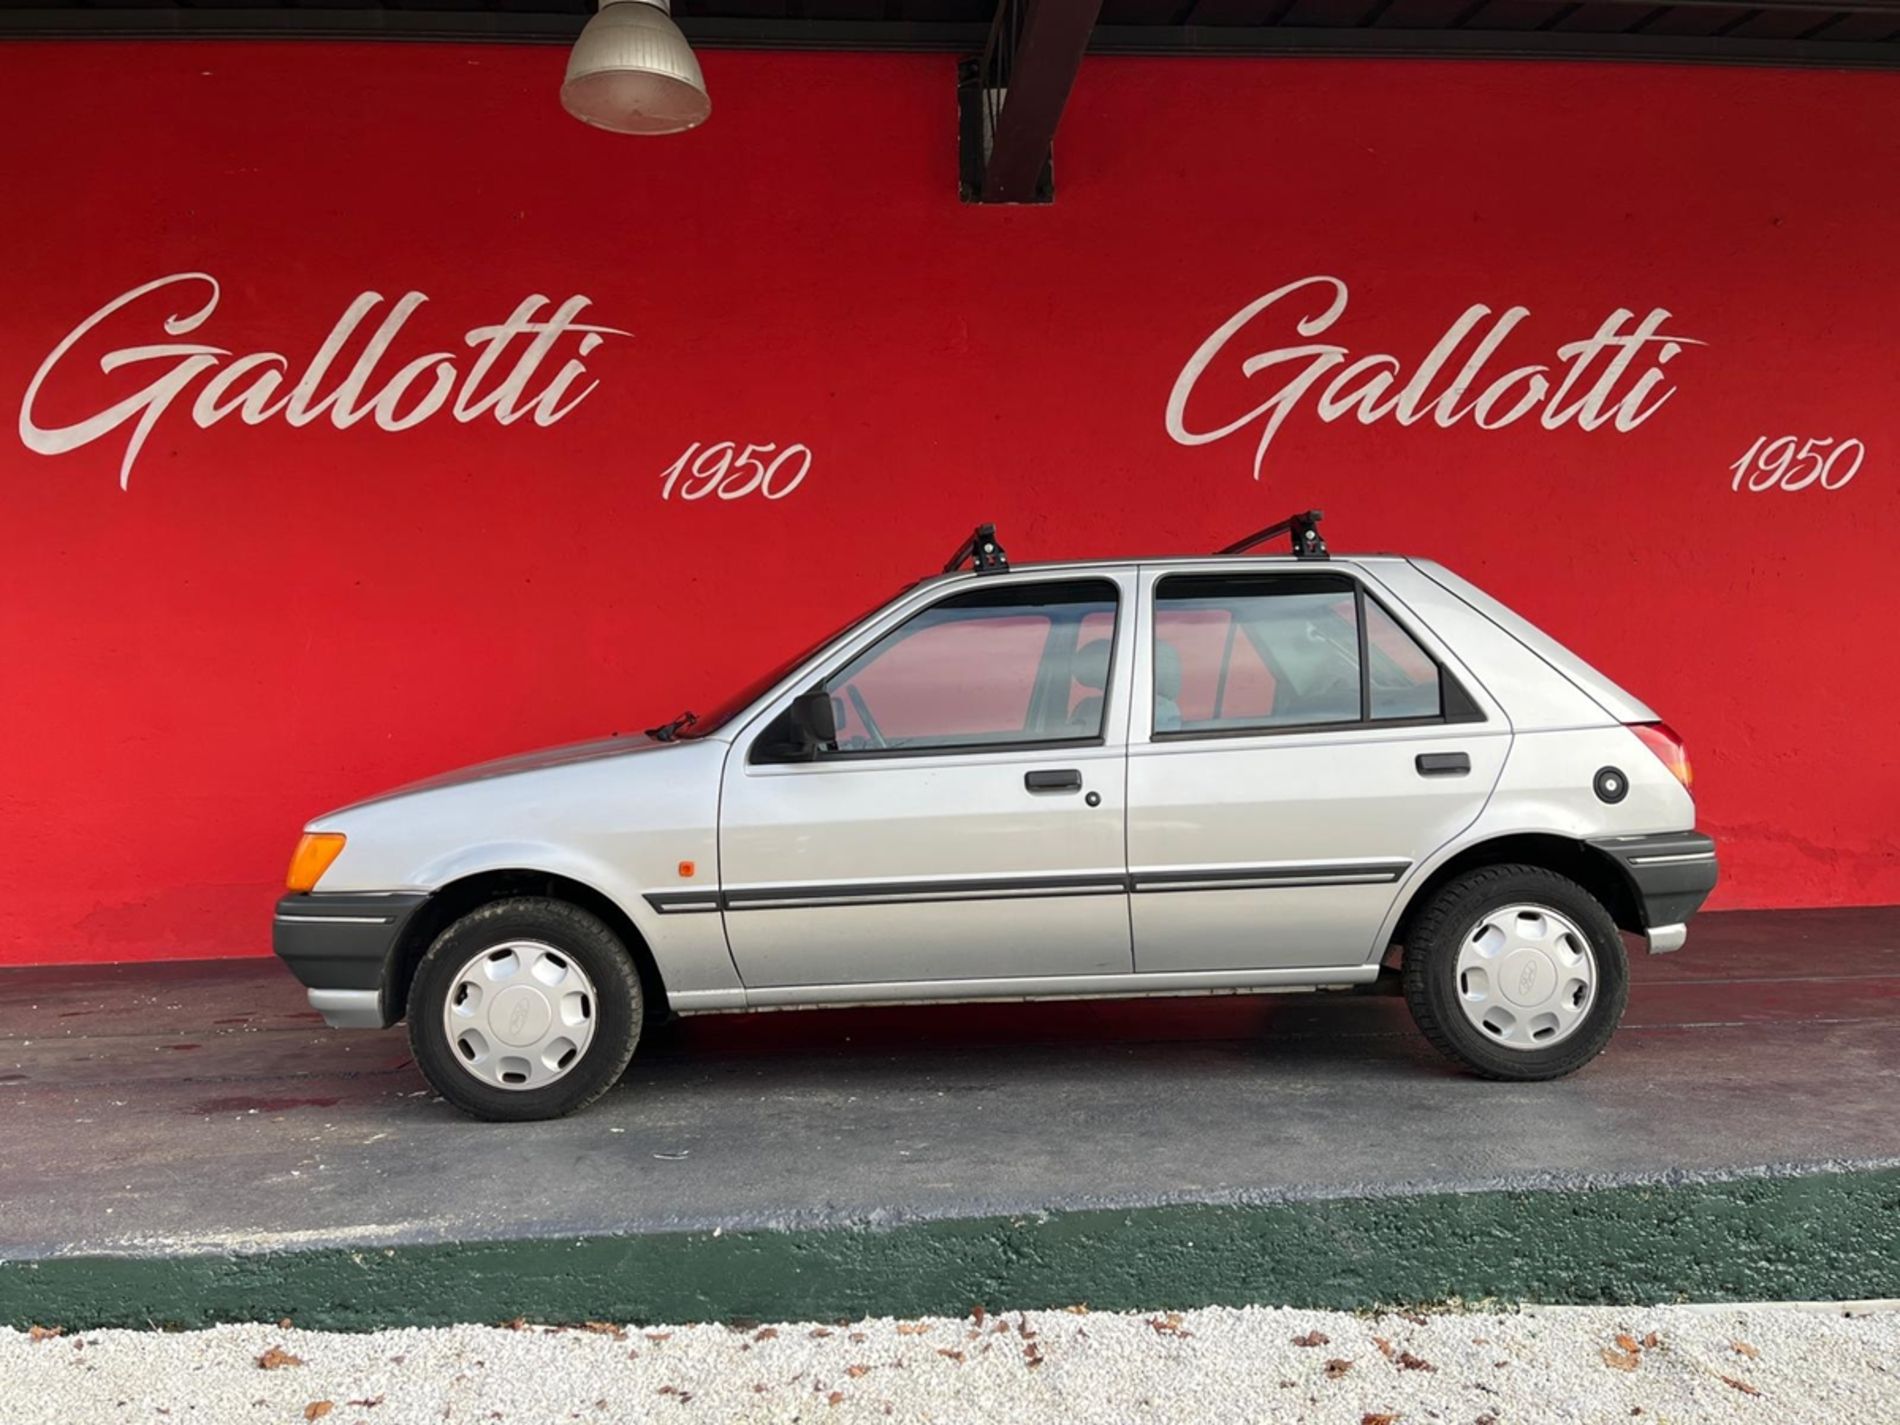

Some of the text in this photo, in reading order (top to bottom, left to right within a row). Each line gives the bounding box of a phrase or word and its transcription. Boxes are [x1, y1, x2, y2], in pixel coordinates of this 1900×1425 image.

[18, 272, 633, 491] Gallotti
[1165, 276, 1707, 480] Gallotti
[660, 441, 812, 500] 1950
[1729, 435, 1865, 492] 1950
